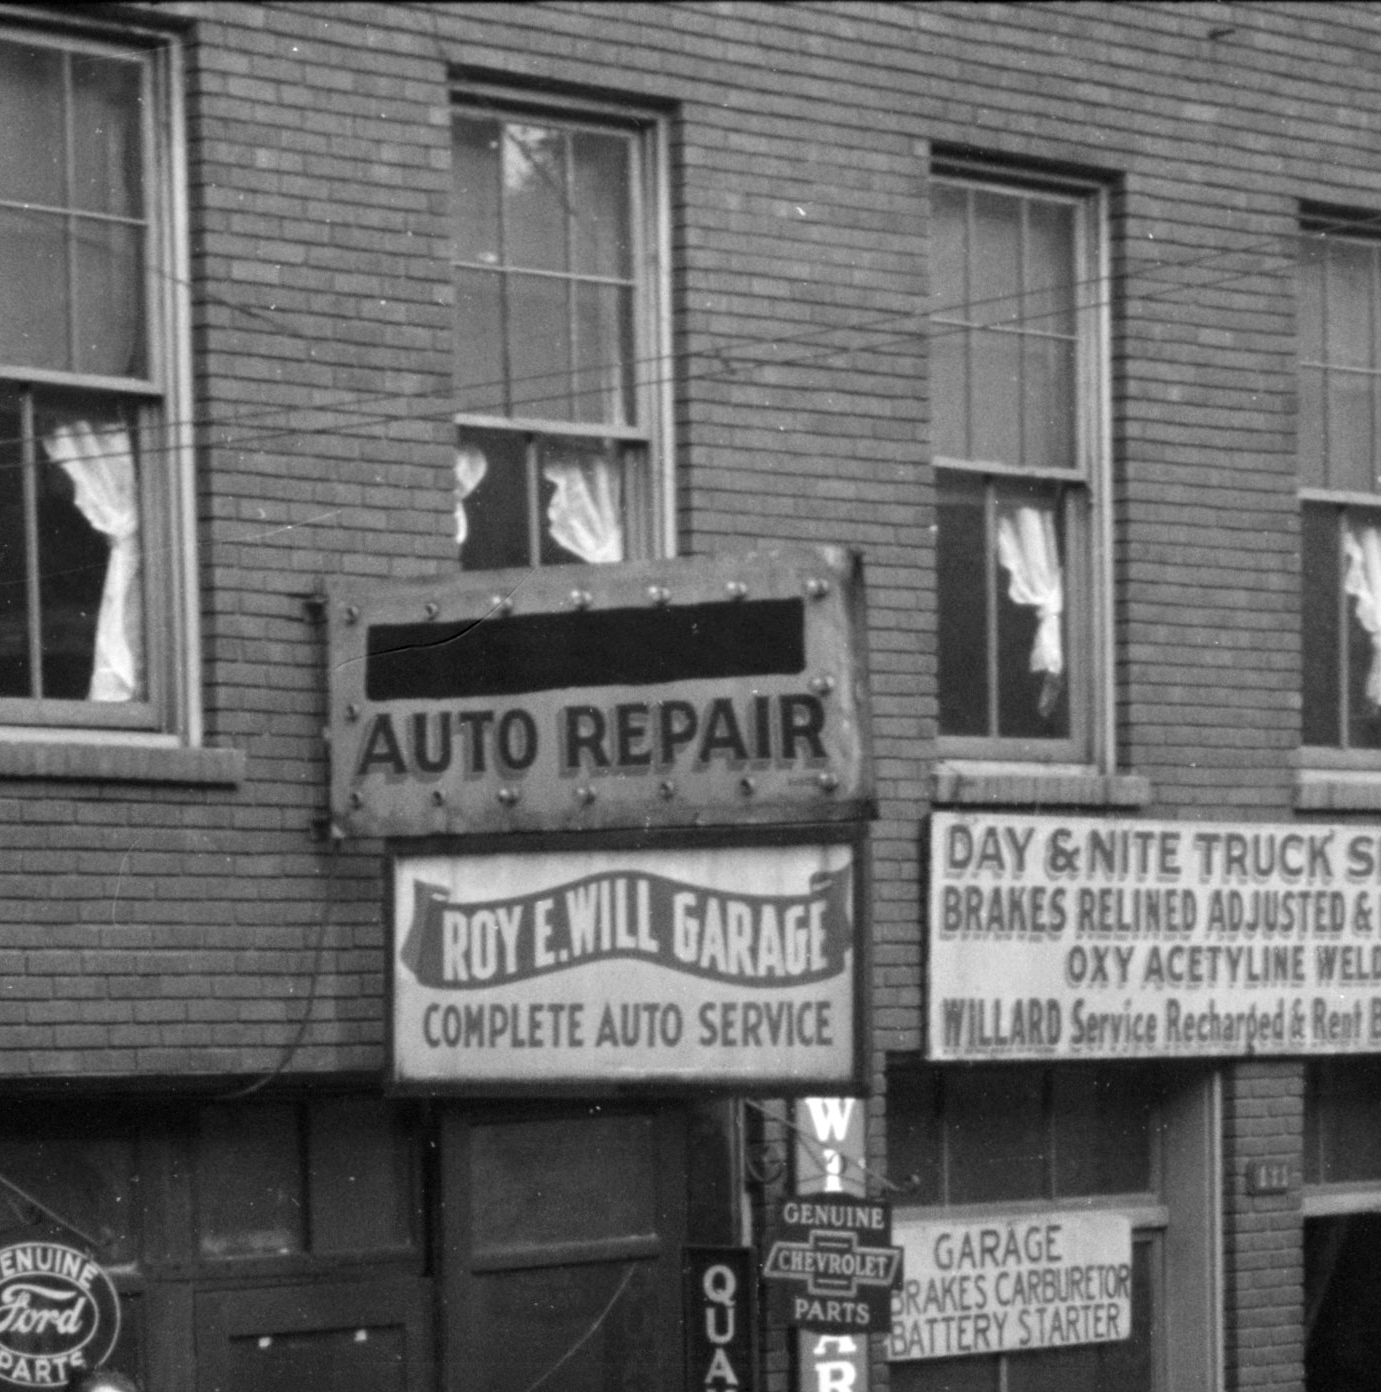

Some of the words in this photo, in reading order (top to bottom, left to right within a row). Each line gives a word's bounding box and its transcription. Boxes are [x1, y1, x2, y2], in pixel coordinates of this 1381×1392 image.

[356, 707, 539, 778] AUTO
[559, 694, 829, 778] REPAIR
[944, 824, 1035, 877] DAY
[1046, 827, 1080, 879] &
[1086, 829, 1182, 880] NITE
[1194, 830, 1333, 882] TRUCK
[442, 906, 523, 981] ROY
[566, 878, 659, 960] WILL
[673, 893, 828, 977] GARAGE
[941, 885, 1068, 939] BRAKES
[1076, 886, 1198, 939] RELINED
[1207, 888, 1346, 939] ADJUSTED
[1352, 890, 1374, 937] &
[1067, 945, 1135, 986] OXY
[1142, 945, 1305, 987] ACETYLINE
[422, 1003, 585, 1050] COMPLETE
[595, 1002, 684, 1049] AUTO
[699, 1001, 834, 1048] SERVICE
[941, 998, 1062, 1047] WILLARD
[1070, 998, 1157, 1044] Service
[1312, 996, 1363, 1040] Rent
[783, 1203, 885, 1229] GENUINE
[778, 1250, 888, 1278] CHEVROLET
[934, 1225, 1062, 1271] GARAGE
[995, 1264, 1131, 1306] CARBURETOR
[795, 1298, 870, 1324] PARTS
[890, 1312, 1008, 1357] BATTERY
[1018, 1303, 1120, 1346] STARTER
